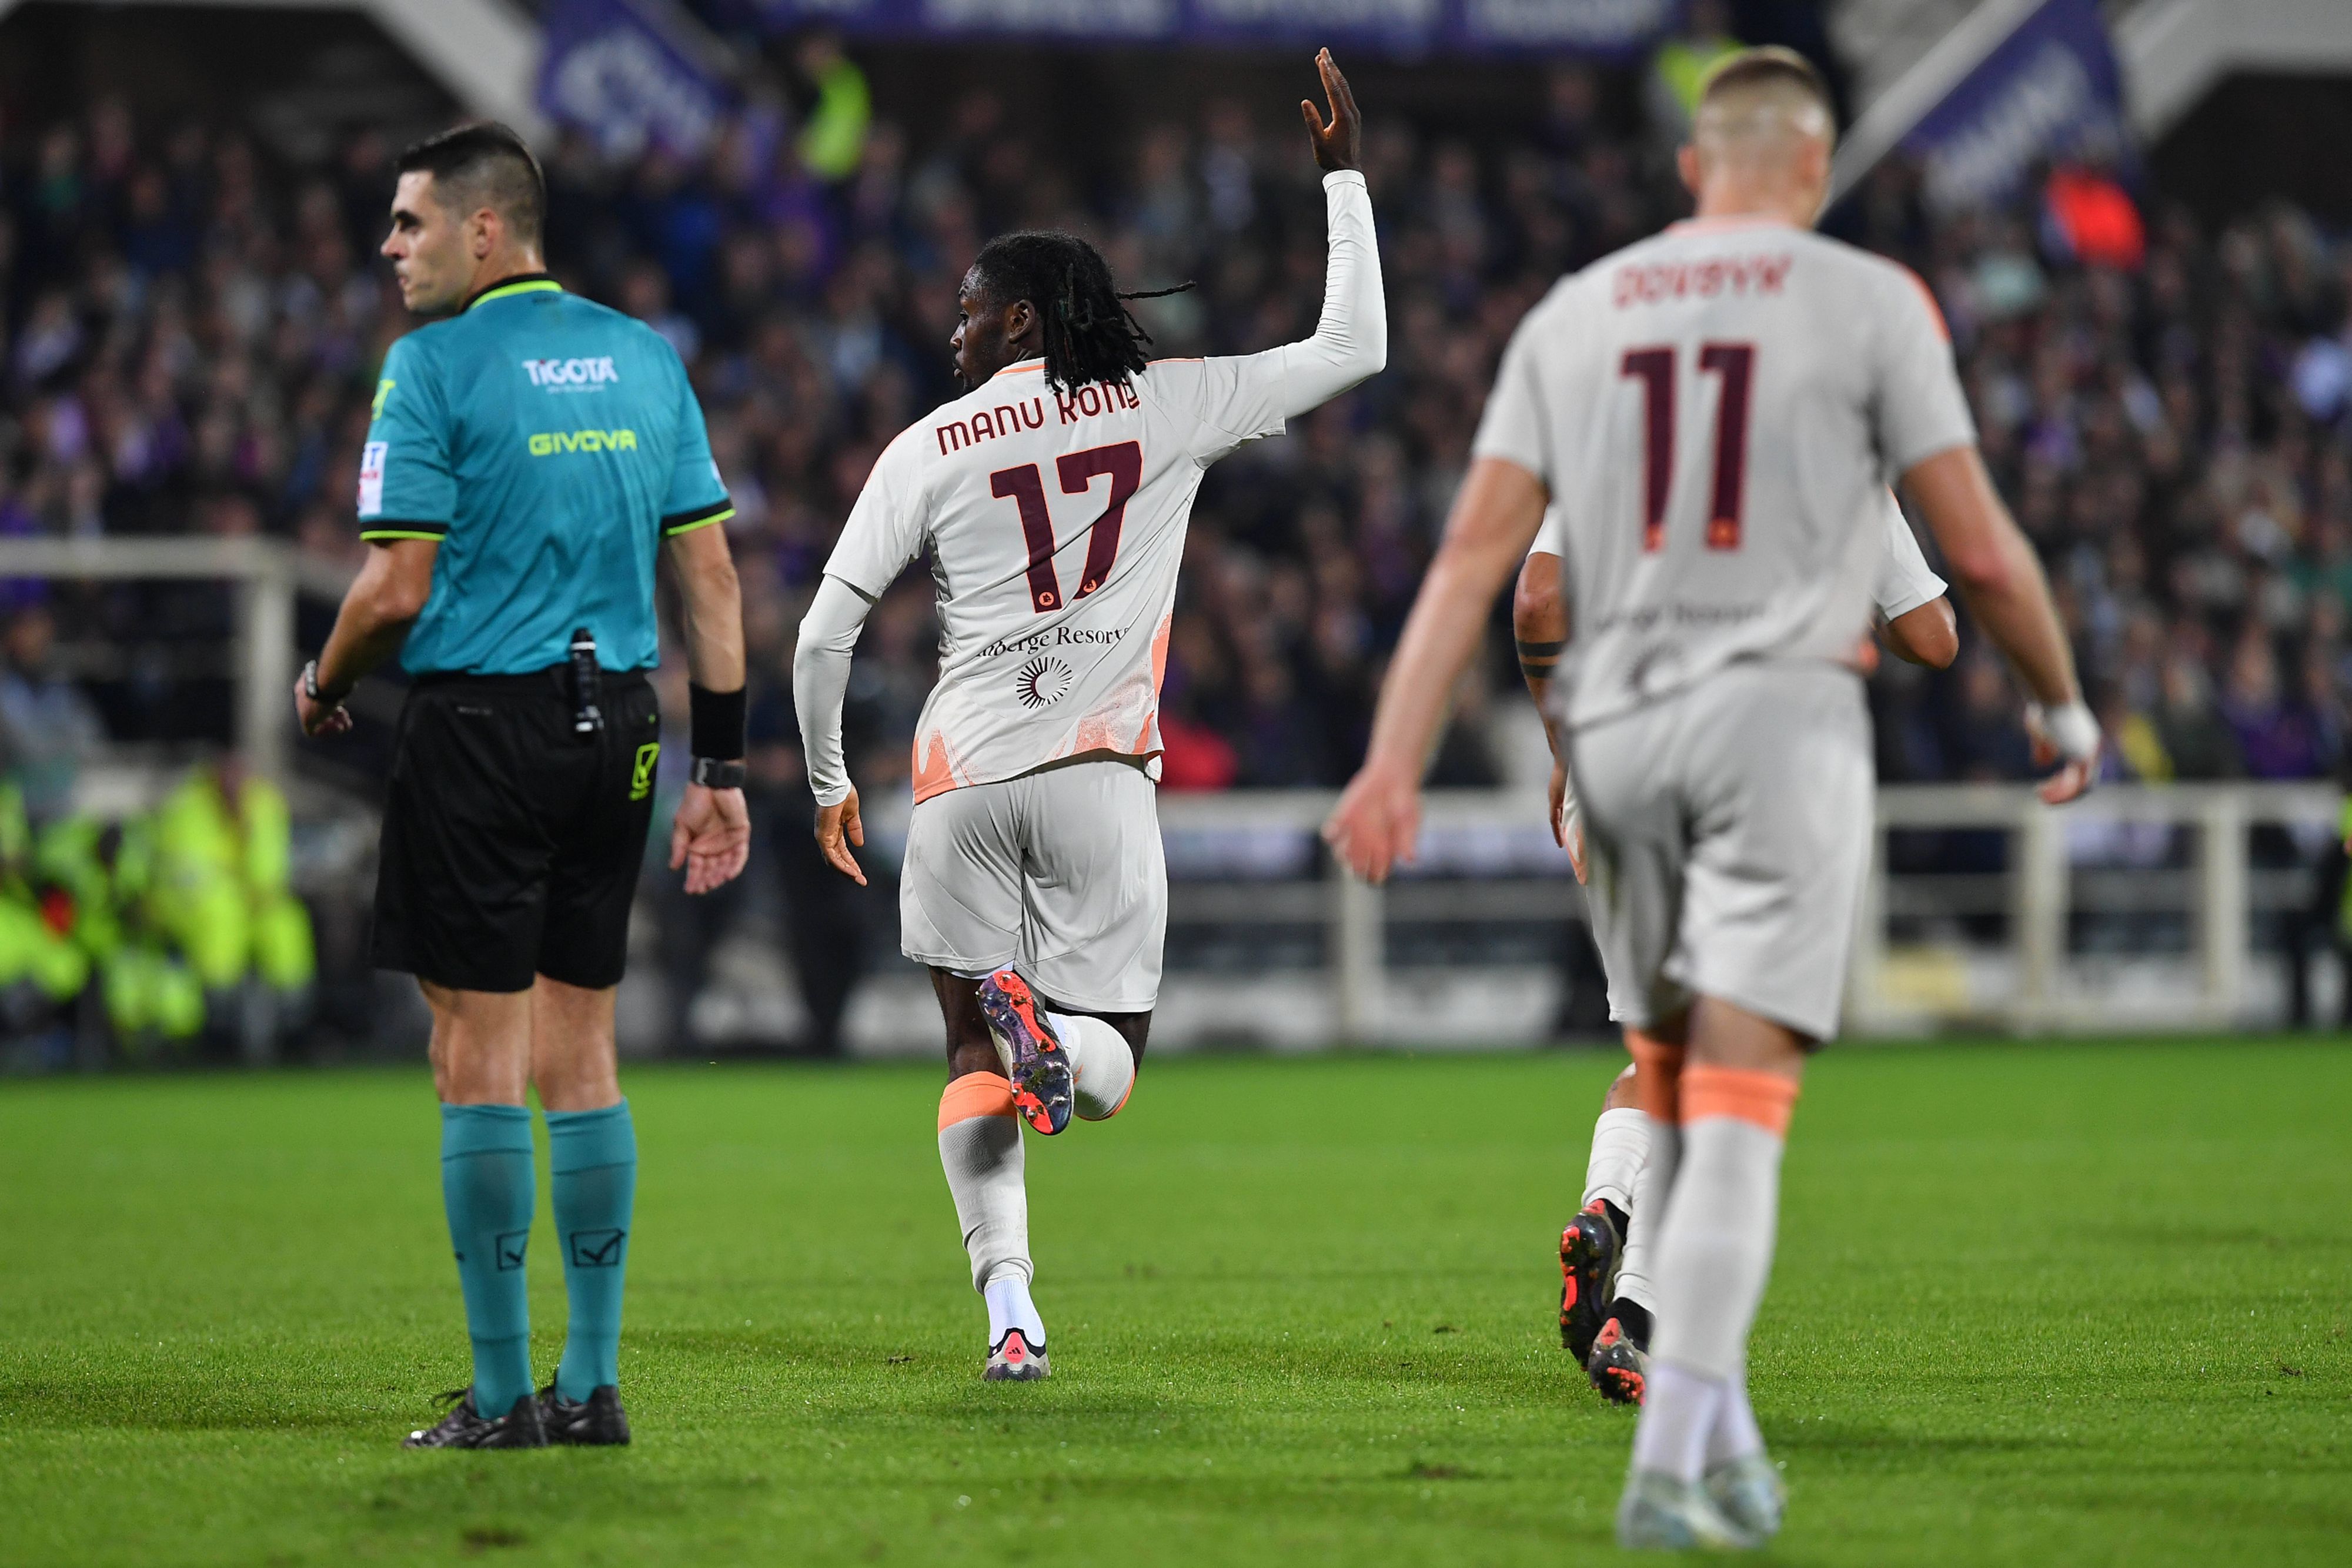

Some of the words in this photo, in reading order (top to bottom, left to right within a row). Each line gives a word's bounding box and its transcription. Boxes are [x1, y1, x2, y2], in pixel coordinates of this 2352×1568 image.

[529, 429, 637, 456] GIVOVA
[936, 397, 1044, 456] MANU
[1619, 336, 1757, 553] 11
[990, 440, 1143, 613] 17
[976, 634, 1050, 654] berge
